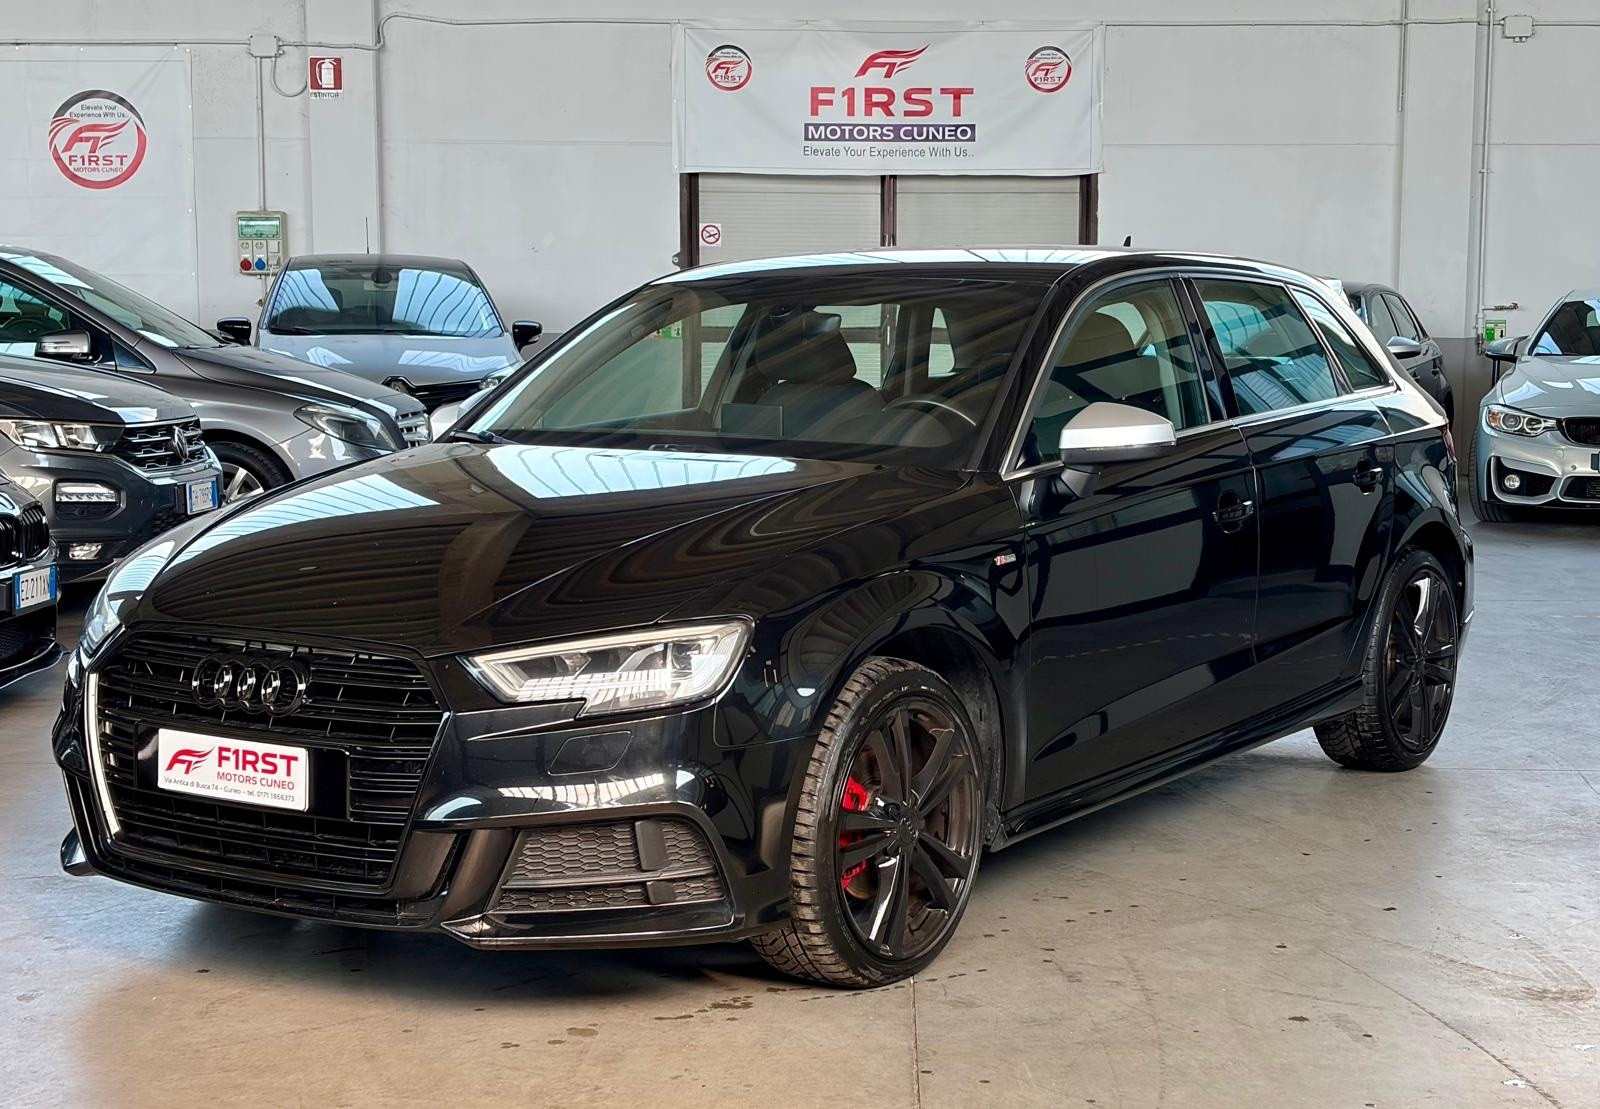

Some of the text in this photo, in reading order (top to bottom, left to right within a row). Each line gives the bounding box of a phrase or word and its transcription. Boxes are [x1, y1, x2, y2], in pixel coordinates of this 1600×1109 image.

[810, 86, 974, 117] F1RST
[808, 125, 972, 140] MOTORS CUNEO
[68, 154, 128, 166] F1RST
[802, 146, 841, 157] Elevate
[843, 146, 867, 158] Your
[869, 146, 926, 160] Experience
[928, 146, 951, 158] With
[217, 746, 299, 777] F1RST
[163, 776, 172, 784] Via
[211, 783, 219, 791] 74
[223, 785, 242, 795] Cuneo
[216, 771, 295, 791] MOTORS CUNEO
